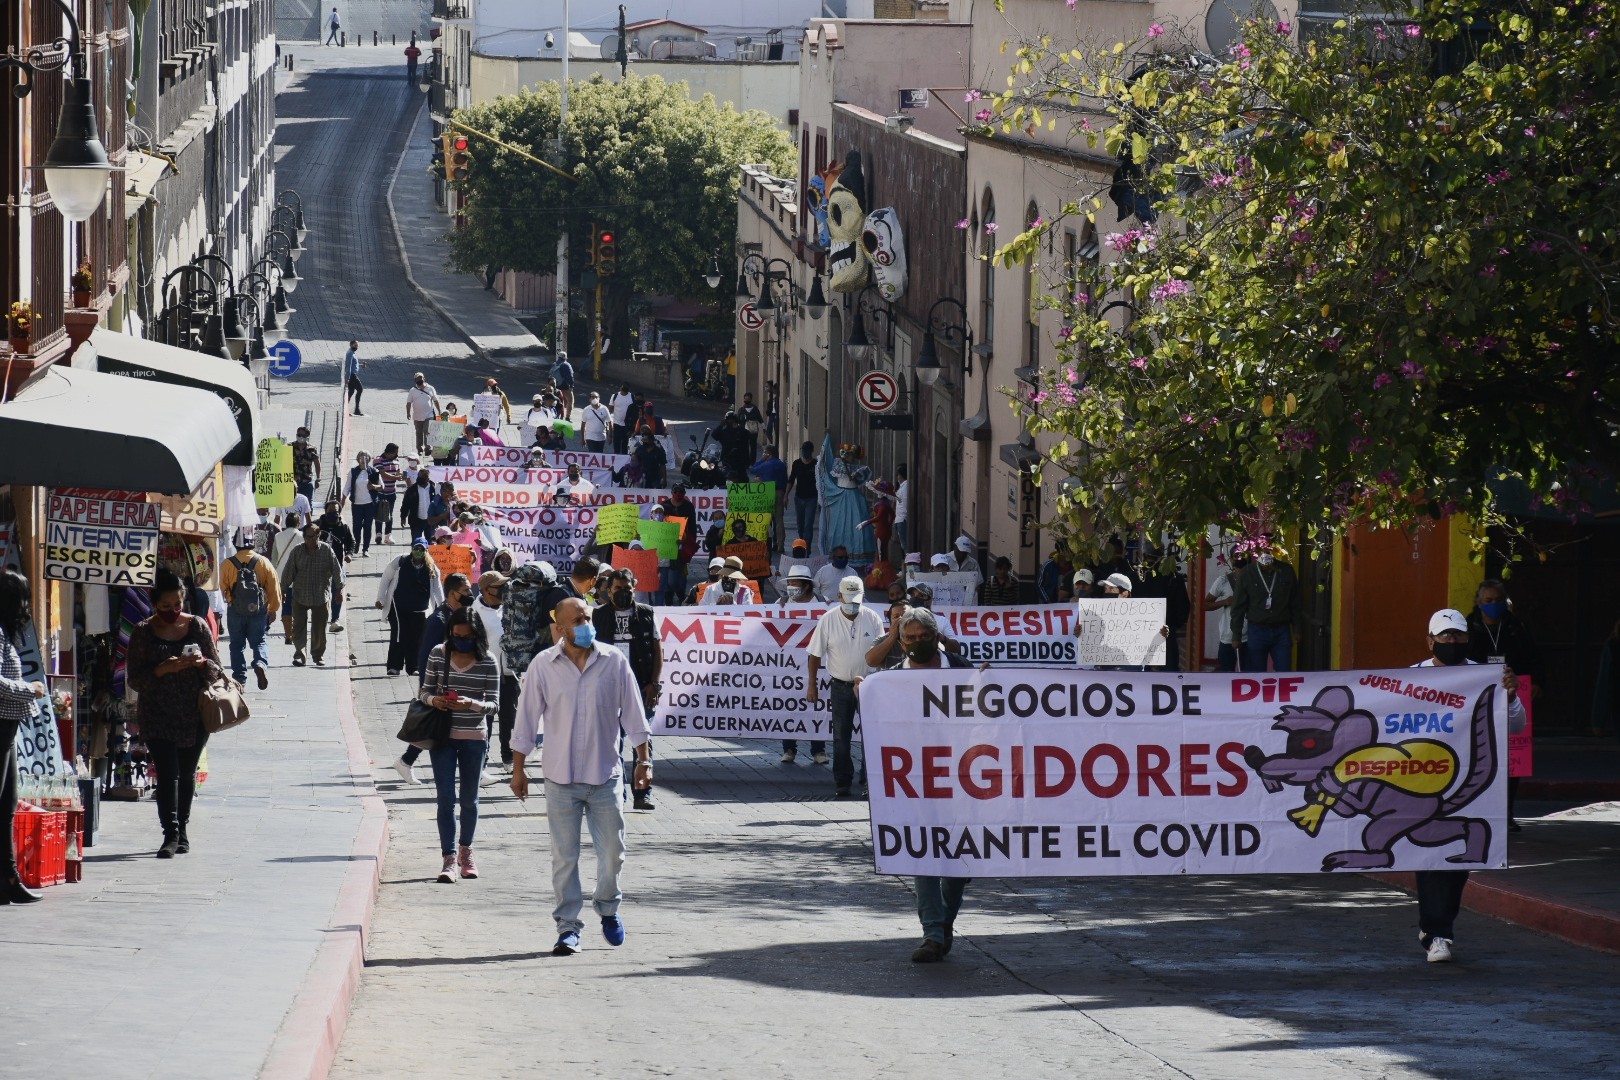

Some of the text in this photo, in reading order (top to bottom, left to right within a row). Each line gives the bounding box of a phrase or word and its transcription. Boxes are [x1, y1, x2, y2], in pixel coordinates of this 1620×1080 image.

[275, 347, 290, 370] E
[554, 449, 616, 468] TOTAL!
[284, 472, 294, 483] DE
[444, 467, 518, 483] ¡APOYO
[258, 484, 273, 496] SUS
[457, 489, 531, 505] ESPIDO
[537, 491, 616, 507] MSIVO
[624, 494, 650, 505] EN
[729, 482, 766, 495] AMLO
[49, 496, 158, 528] PAPELERIA
[562, 509, 598, 525] TO
[1021, 472, 1034, 548] OTEL
[48, 523, 157, 551] INTERNET
[500, 525, 595, 540] EMPLEADOS DES
[46, 545, 156, 569] ESCRITOS
[502, 542, 575, 556] NTAMIENTO
[45, 562, 154, 586] COPIAS
[1081, 600, 1162, 617] VILLALOBOS
[661, 616, 742, 645] ME
[946, 609, 1075, 637] NECESIT
[687, 648, 801, 671] CIUDADANÍA,
[959, 641, 1076, 661] DESPEDIDOS
[670, 670, 766, 692] COMERCIO,
[772, 675, 804, 691] LOS
[668, 692, 700, 709] LOS
[706, 694, 808, 713] EMPLEADOS
[922, 682, 1202, 719] NEGOCIOS DE
[665, 714, 687, 730] DE
[692, 714, 807, 734] CUERNAVACA
[811, 719, 825, 734] Y
[1384, 711, 1454, 735] SAPAC
[880, 741, 1249, 800] REGIDORES
[878, 822, 1261, 861] DURANTE EL COVID
